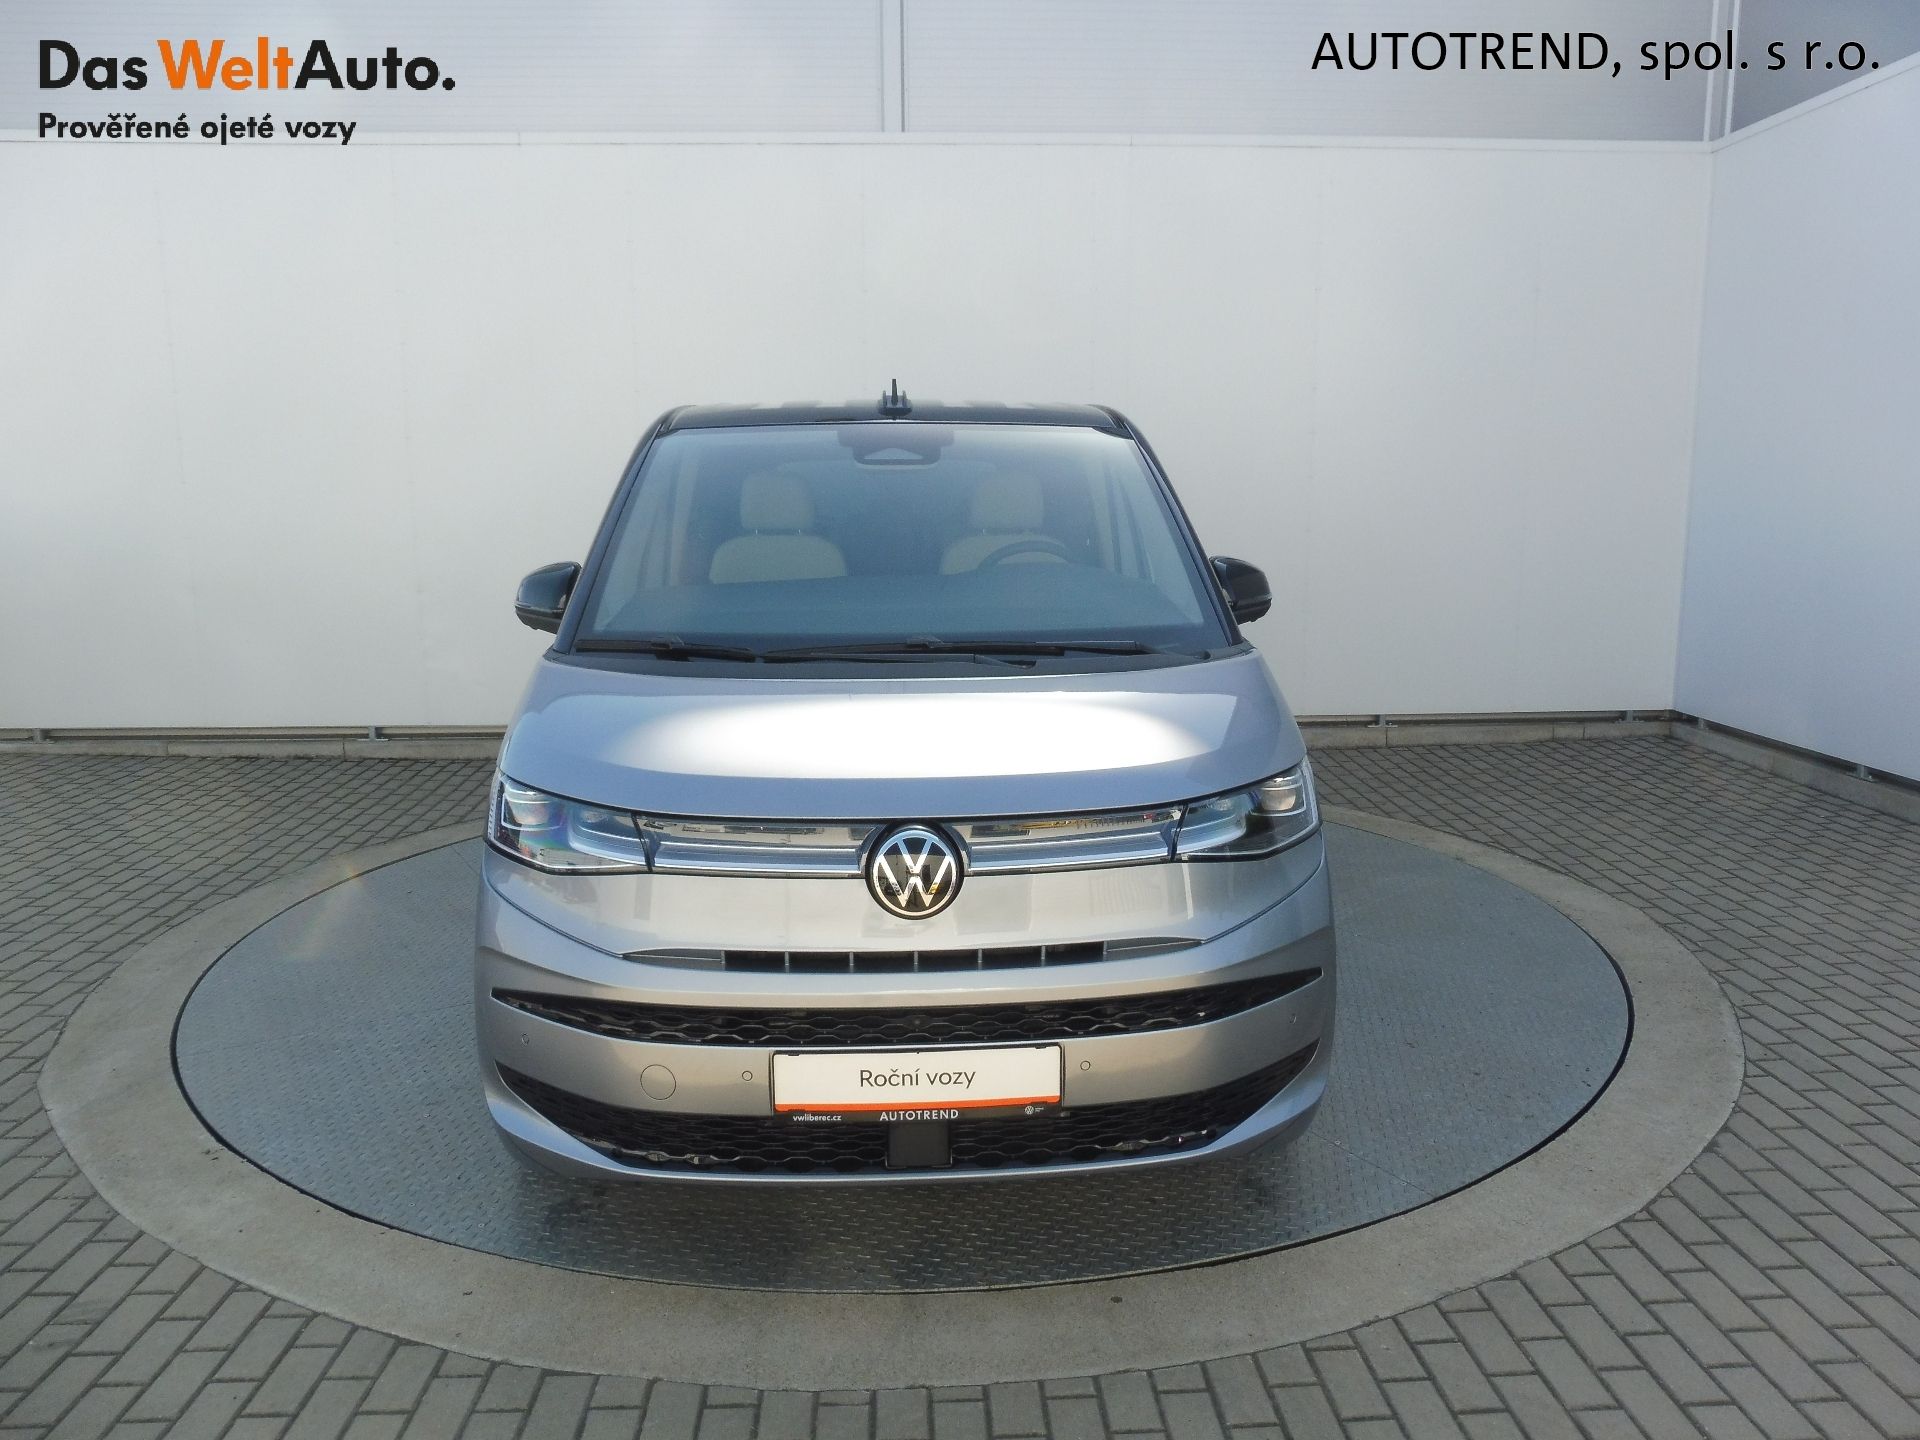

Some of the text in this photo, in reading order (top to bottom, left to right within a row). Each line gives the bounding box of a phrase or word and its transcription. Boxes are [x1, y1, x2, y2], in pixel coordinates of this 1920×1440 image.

[859, 1068, 976, 1089] Roční vozy
[792, 1113, 842, 1122] vwliberec.cz
[879, 1109, 959, 1122] AUTOTREND
